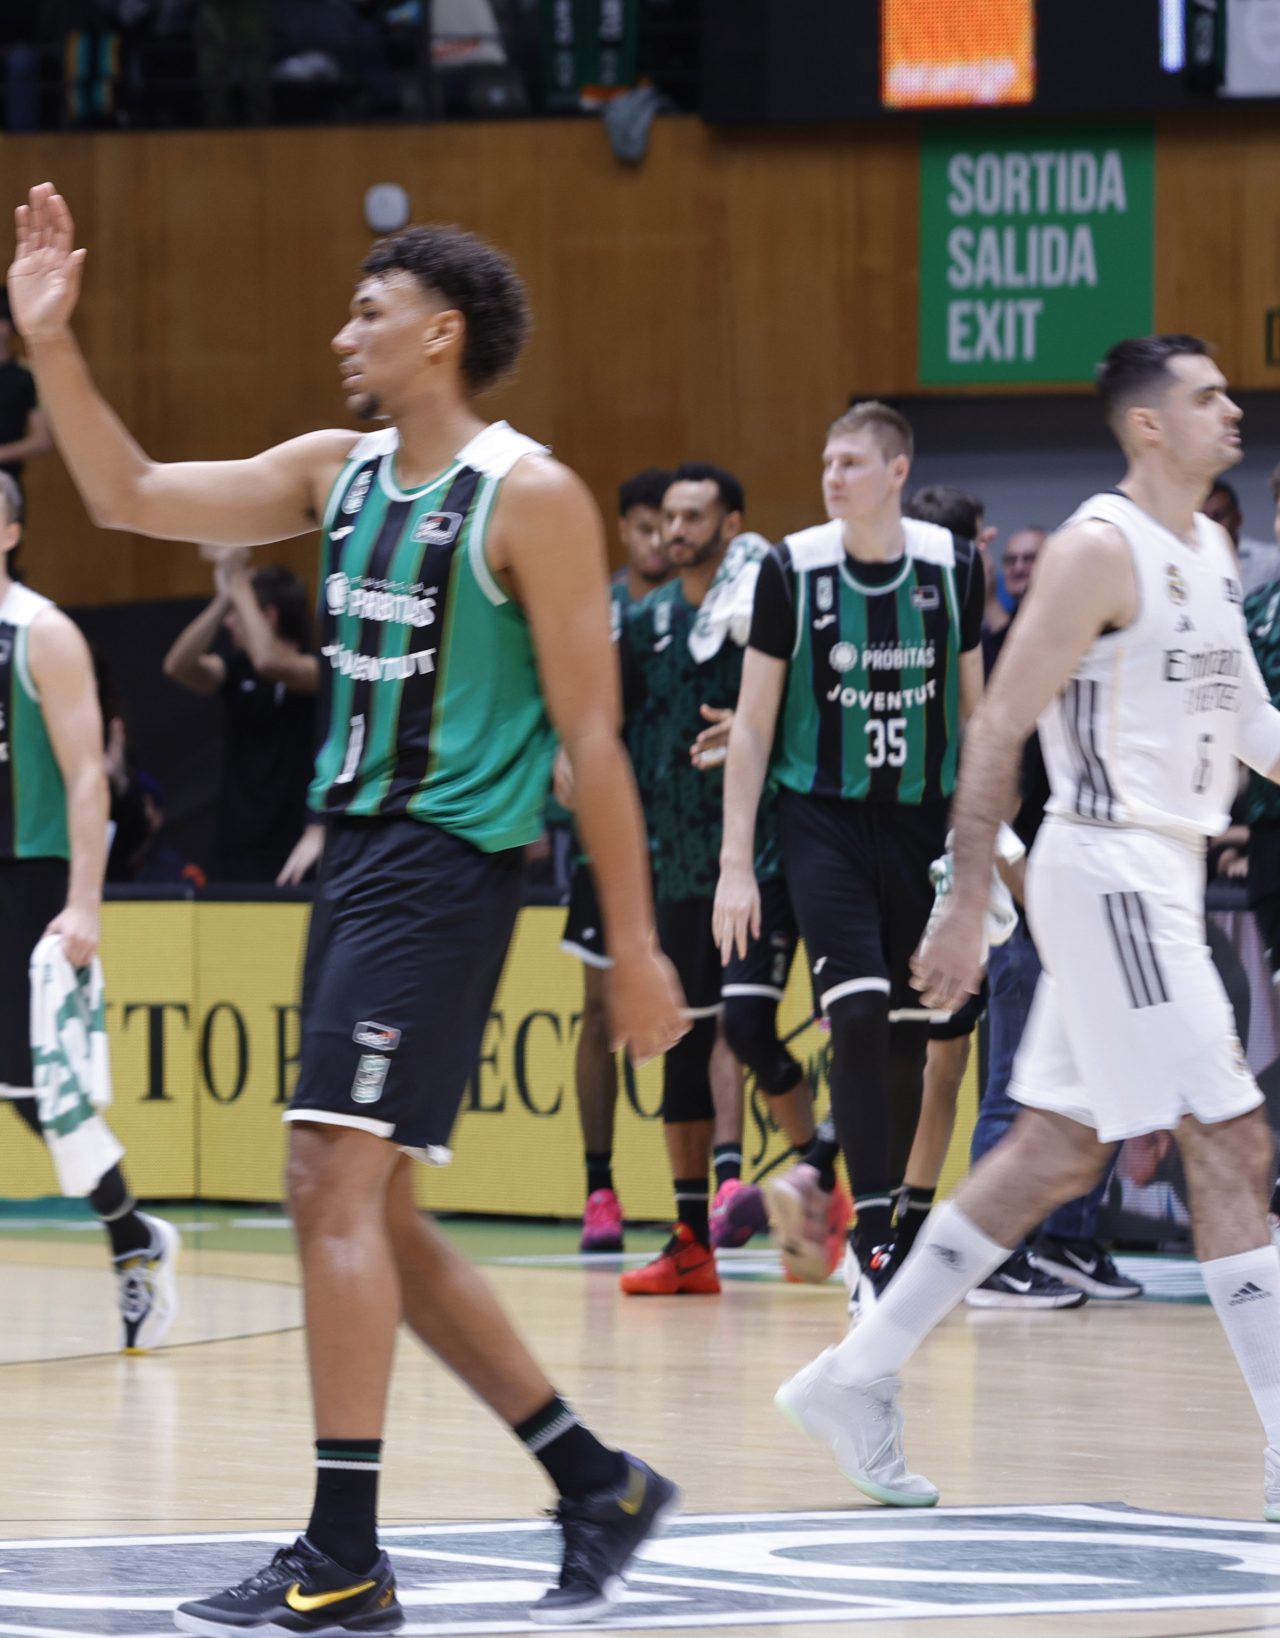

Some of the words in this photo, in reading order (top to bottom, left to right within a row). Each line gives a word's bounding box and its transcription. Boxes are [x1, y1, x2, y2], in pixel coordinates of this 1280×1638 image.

[948, 149, 1127, 216] SORTIDA
[947, 224, 1097, 289] SALIDA
[948, 299, 1043, 363] EXIT
[862, 646, 936, 671] PROBITAS
[827, 678, 937, 712] JOVENTUT
[864, 717, 909, 768] 35
